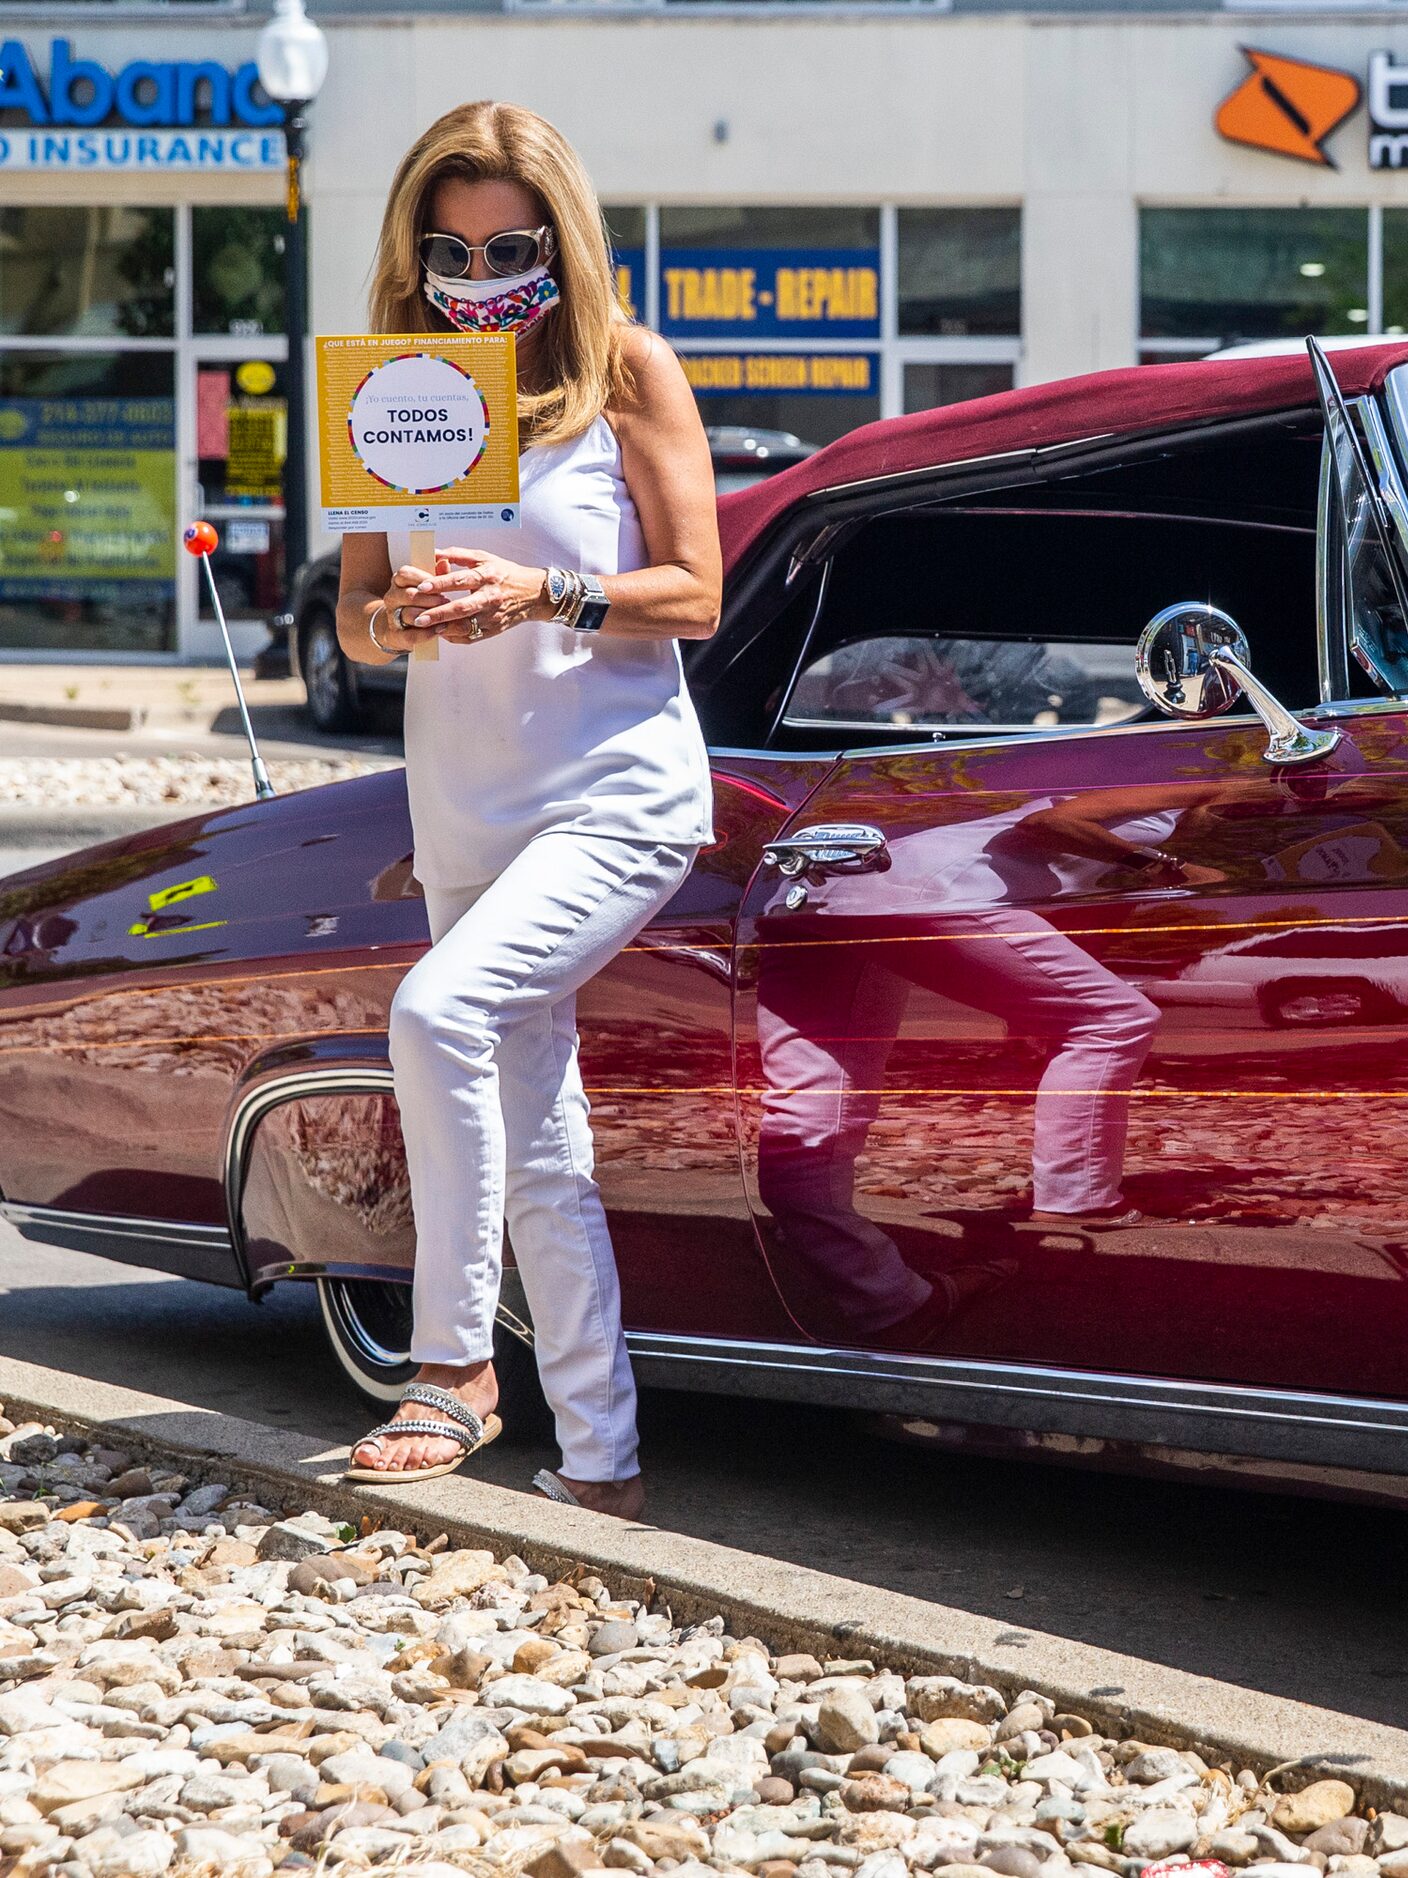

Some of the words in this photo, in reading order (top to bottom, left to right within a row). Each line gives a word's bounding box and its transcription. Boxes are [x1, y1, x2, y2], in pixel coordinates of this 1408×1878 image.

[28, 134, 280, 165] INSURANCE
[664, 267, 757, 321] TRADE
[775, 267, 878, 321] REPAIR
[346, 337, 366, 347] ESTÁ
[367, 338, 378, 346] EN
[380, 337, 412, 346] JUEGO?
[413, 336, 482, 345] FINANCIAMIENTO
[483, 335, 508, 344] PARA:
[745, 356, 808, 388] SCREEN
[810, 357, 869, 389] REPAIR
[381, 394, 416, 404] cuento,
[417, 394, 429, 402] tu
[430, 393, 469, 403] cuentas,
[387, 408, 449, 423] TODOS
[363, 427, 474, 445] CONTAMOS!
